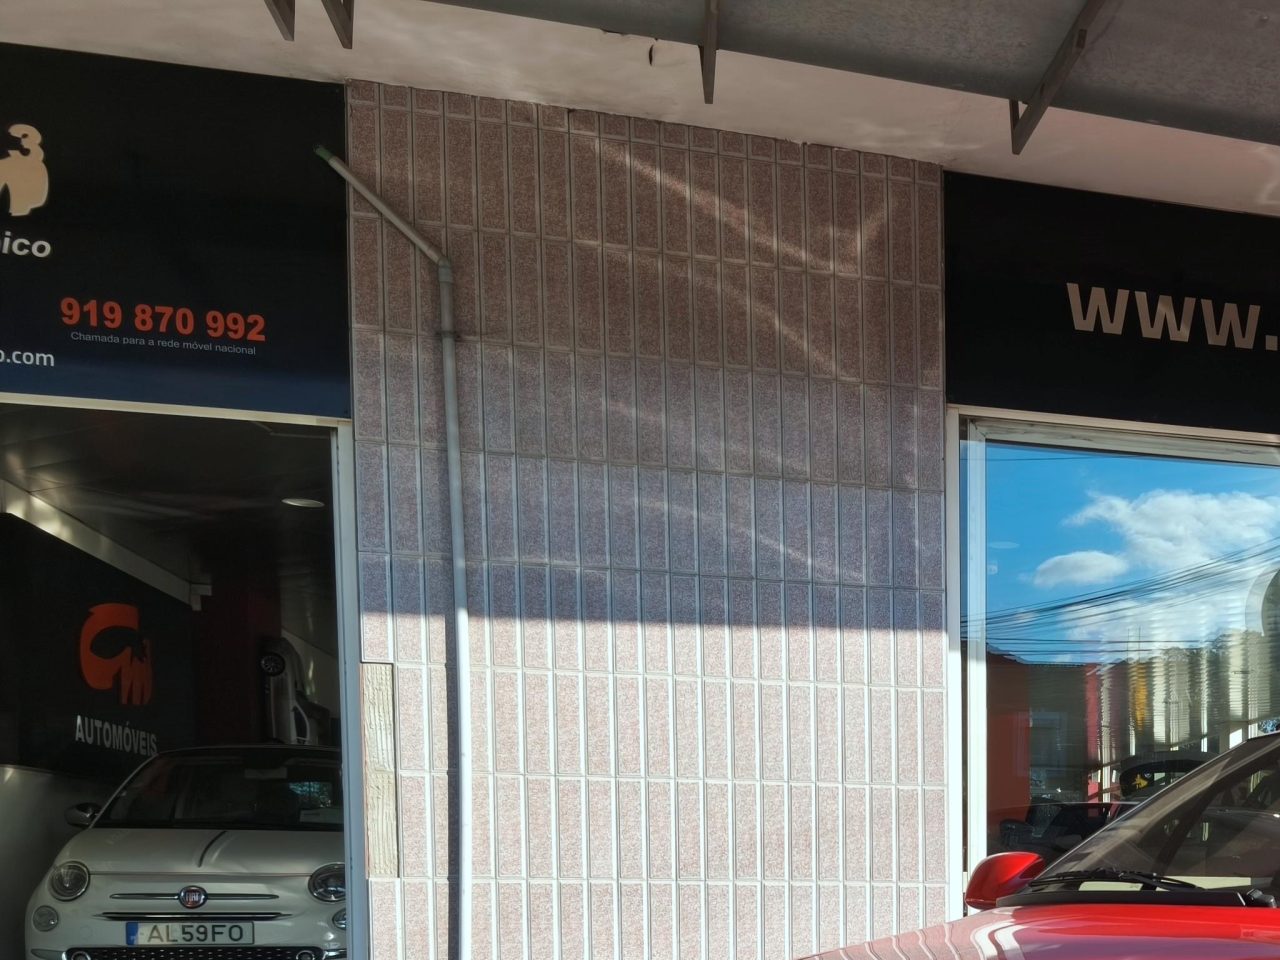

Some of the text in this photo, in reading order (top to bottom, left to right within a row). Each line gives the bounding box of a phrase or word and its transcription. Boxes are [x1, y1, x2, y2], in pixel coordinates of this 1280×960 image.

[0, 230, 52, 258] ico
[61, 297, 266, 342] 919 870 992
[71, 331, 119, 344] Chamada
[123, 336, 145, 347] para
[157, 337, 180, 348] rede
[183, 338, 212, 352] móvel
[215, 342, 256, 355] nacional
[75, 714, 158, 757] AUTOMÓVEIS
